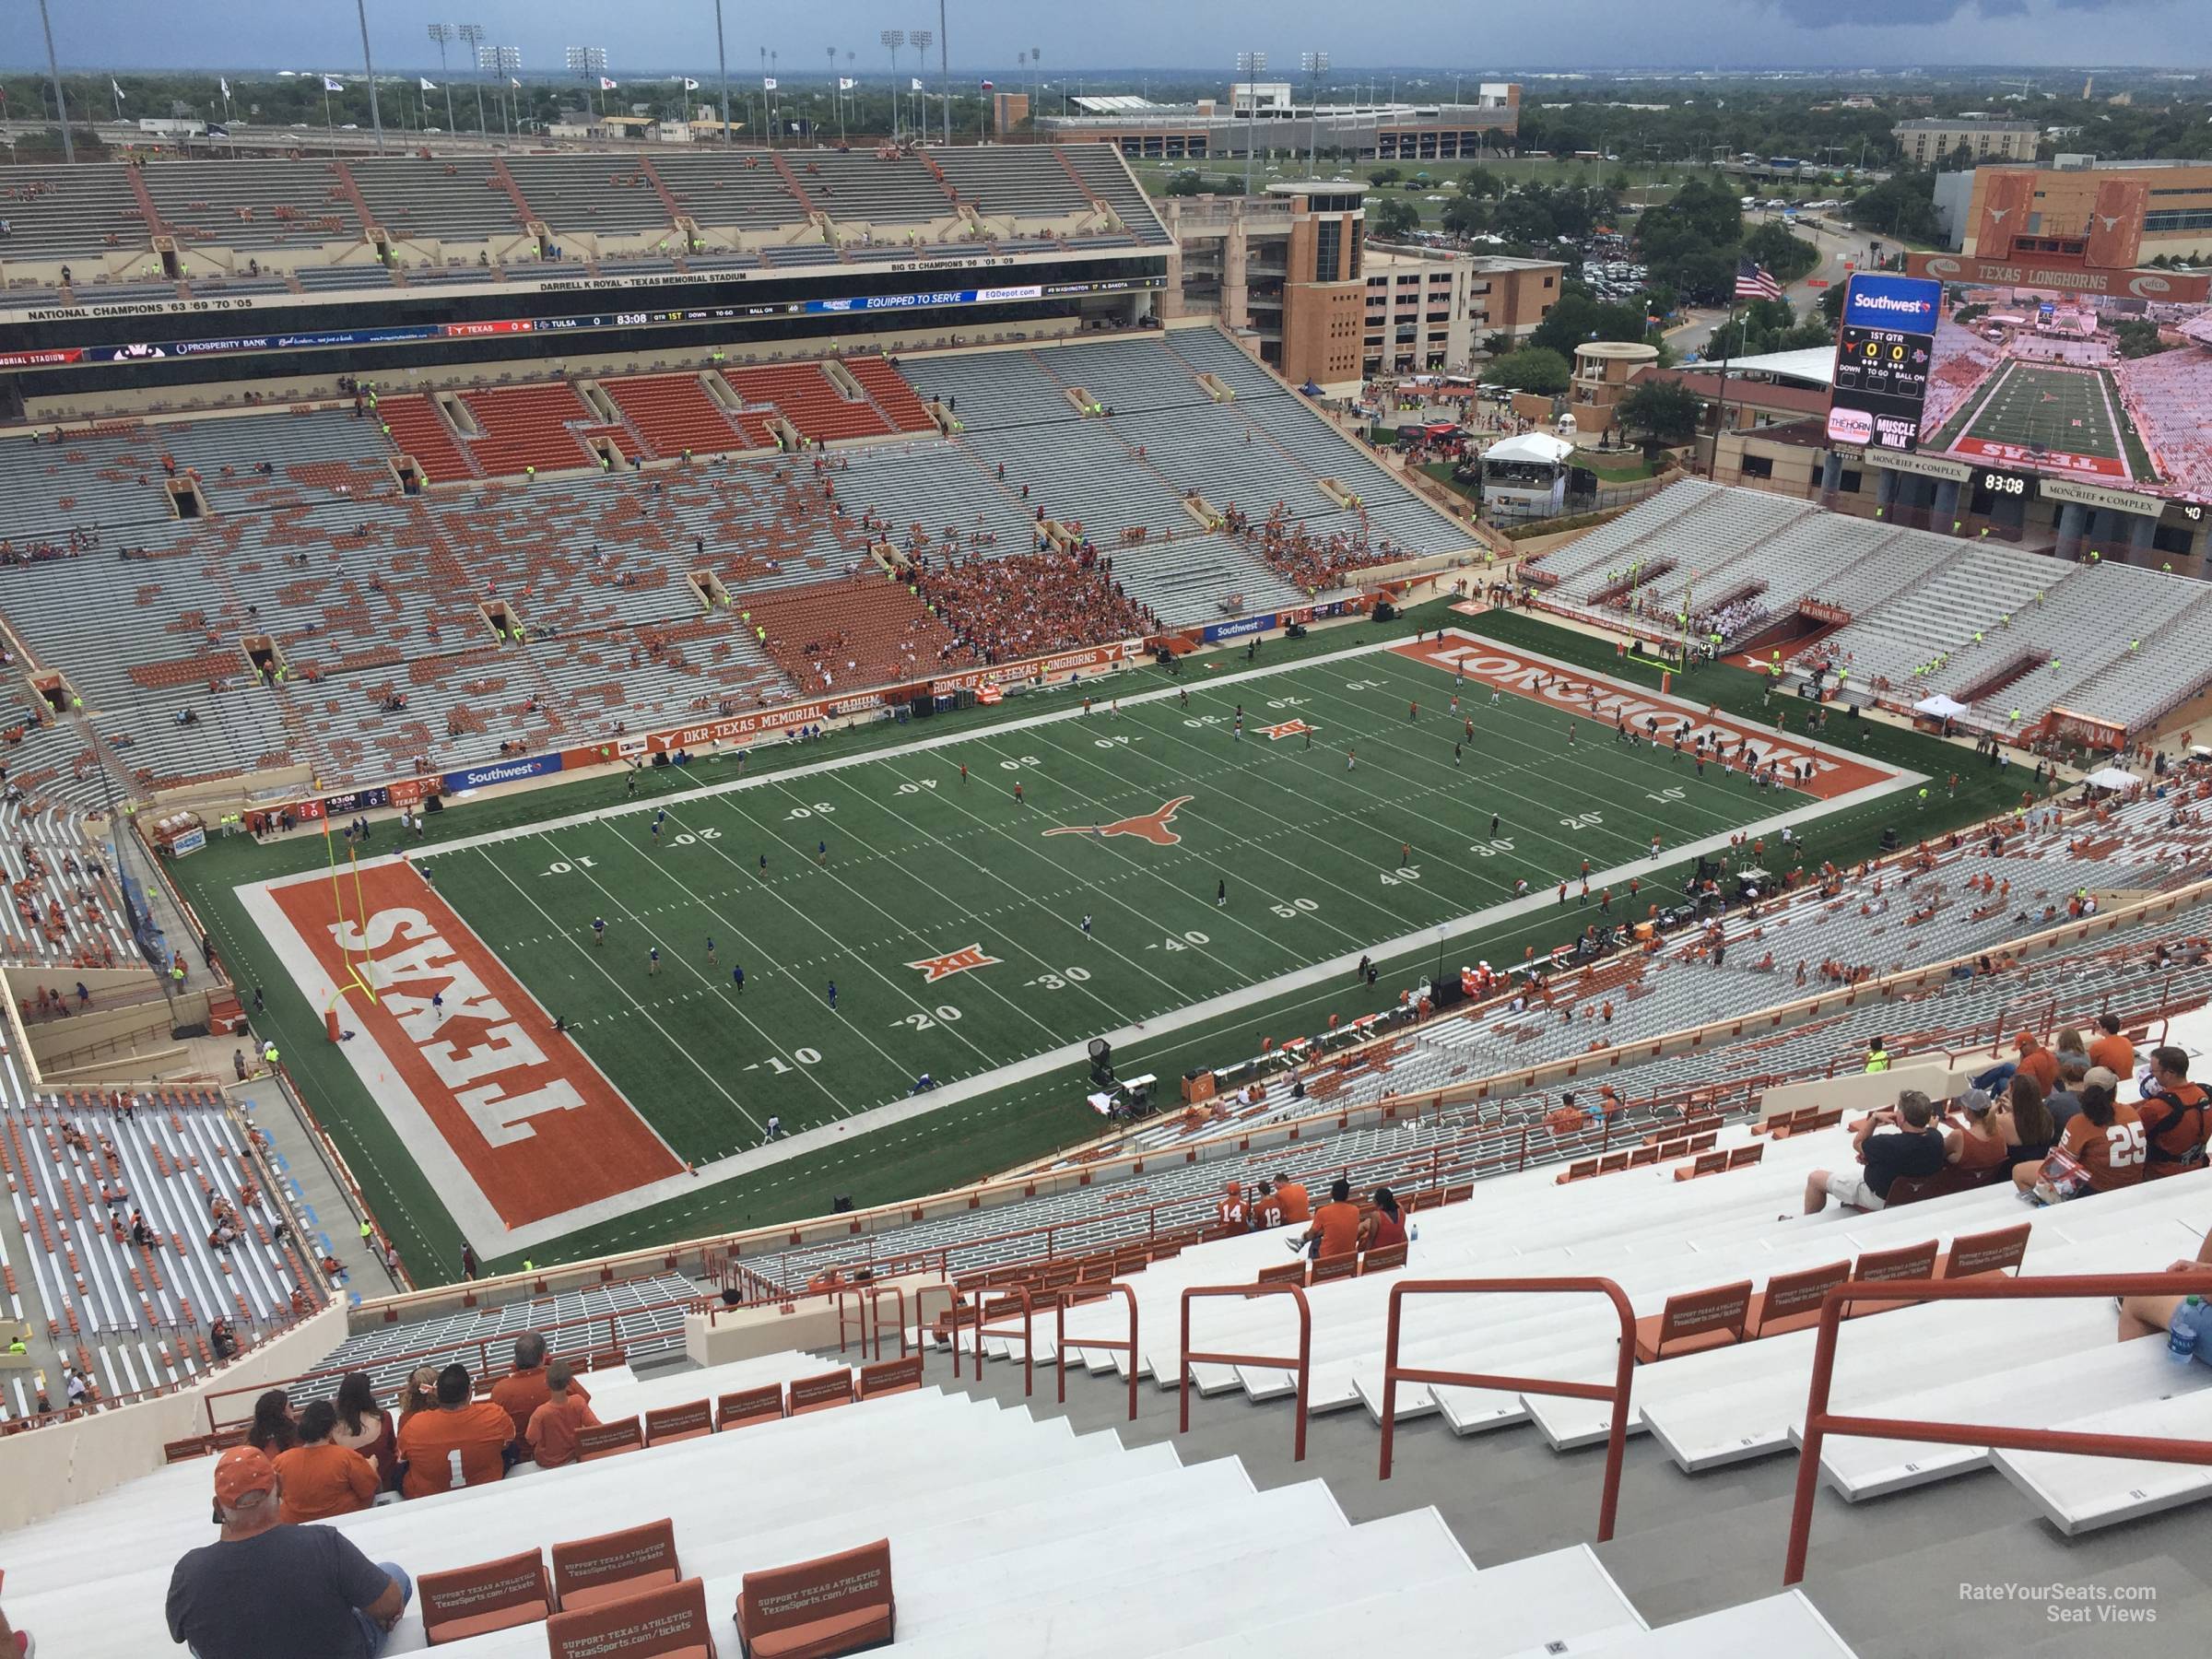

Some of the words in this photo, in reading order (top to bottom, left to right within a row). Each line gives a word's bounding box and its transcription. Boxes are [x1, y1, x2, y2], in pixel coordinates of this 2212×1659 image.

[918, 260, 963, 269] CHAMPIONS
[540, 281, 582, 291] DARRELL
[593, 278, 623, 288] ROYAL
[630, 277, 661, 286] TEXAS
[662, 275, 706, 285] MEMORIAL
[709, 273, 747, 282] STADIUM
[1979, 265, 2022, 282] TEXAS
[2027, 270, 2108, 290] LONGHORNS
[867, 295, 915, 308] EQUIPPED
[917, 294, 930, 304] TO
[931, 293, 961, 303] SERVE
[985, 289, 1035, 299] EQDepot.com
[1854, 293, 1921, 313] Southwest
[28, 308, 89, 320] NATIONAL
[93, 304, 164, 317] CHAMPIONS
[617, 313, 647, 324] 83:08
[668, 312, 682, 320] 1ST
[467, 324, 494, 333] TEXAS
[551, 319, 577, 328] TULSA
[188, 340, 240, 351] PROSPERITY
[243, 338, 267, 347] BANK
[1870, 331, 1883, 341] 1ST
[1886, 333, 1904, 343] QTR
[30, 353, 65, 363] STADIUM
[1866, 342, 1877, 357] 0
[1892, 345, 1903, 360] 0
[1839, 364, 1861, 374] DOWN
[1868, 368, 1877, 377] TO
[1878, 369, 1889, 378] GO
[1895, 371, 1912, 381] BALL
[1913, 374, 1925, 383] ON
[1877, 419, 1917, 436] MUSCLE
[1882, 432, 1907, 448] MILK
[1872, 454, 1912, 469] MONCRIEF
[1922, 463, 1962, 477] COMPLEX
[1985, 474, 2024, 494] 83:08
[2049, 485, 2097, 501] MONCRIEF
[2106, 496, 2154, 512] COMPLEX
[2184, 506, 2201, 520] 40
[1217, 620, 1259, 637] Southwest
[933, 678, 962, 694] HOME
[966, 675, 979, 687] OF
[1346, 679, 1382, 691] 10
[1265, 695, 1304, 710] 20
[1182, 715, 1223, 729] 30
[1426, 645, 1842, 781] LONGHORNS
[683, 721, 756, 744] DKR-TEXAS
[761, 707, 824, 729] MEMORIAL
[1094, 735, 1133, 749] 40
[999, 755, 1042, 771] 50
[467, 763, 534, 785] Southwest
[899, 778, 940, 795] 40
[1645, 785, 1686, 804] 10
[370, 797, 377, 806] 0
[395, 796, 418, 807] TEXAS
[790, 801, 837, 820] 30
[1559, 812, 1604, 830] 20
[675, 827, 723, 847] 20
[1469, 837, 1515, 858] 30
[550, 855, 599, 875] 10
[1378, 866, 1421, 887] 40
[1269, 897, 1320, 919] 50
[1162, 930, 1211, 953] 40
[1038, 966, 1093, 991] 30
[327, 906, 588, 1149] TEXAS
[904, 1005, 963, 1031] 20
[763, 1046, 823, 1075] 10
[2106, 1120, 2147, 1168] 25
[1222, 1203, 1242, 1223] 14
[1264, 1207, 1282, 1228] 12
[447, 1448, 467, 1489] 1
[565, 1560, 598, 1571] SUPPORT
[600, 1554, 624, 1566] TEXAS
[625, 1542, 665, 1559] ATHLETICS
[568, 1550, 664, 1578] TexasSports.com/tickets
[431, 1588, 465, 1602] SUPPORT
[467, 1582, 493, 1597] TEXAS
[495, 1571, 537, 1590] ATHLETICS
[435, 1579, 535, 1609] TexasSports.com/tickets
[759, 1591, 799, 1607] SUPPORT
[800, 1583, 830, 1597] TEXAS
[832, 1568, 881, 1589] ATHLETICS
[761, 1579, 878, 1616] TexasSports.com/tickets
[562, 1634, 605, 1651] SUPPORT
[607, 1625, 640, 1641] TEXAS
[641, 1610, 693, 1632] ATHLETICS
[566, 1620, 692, 1659] TexasSports.com/tickets
